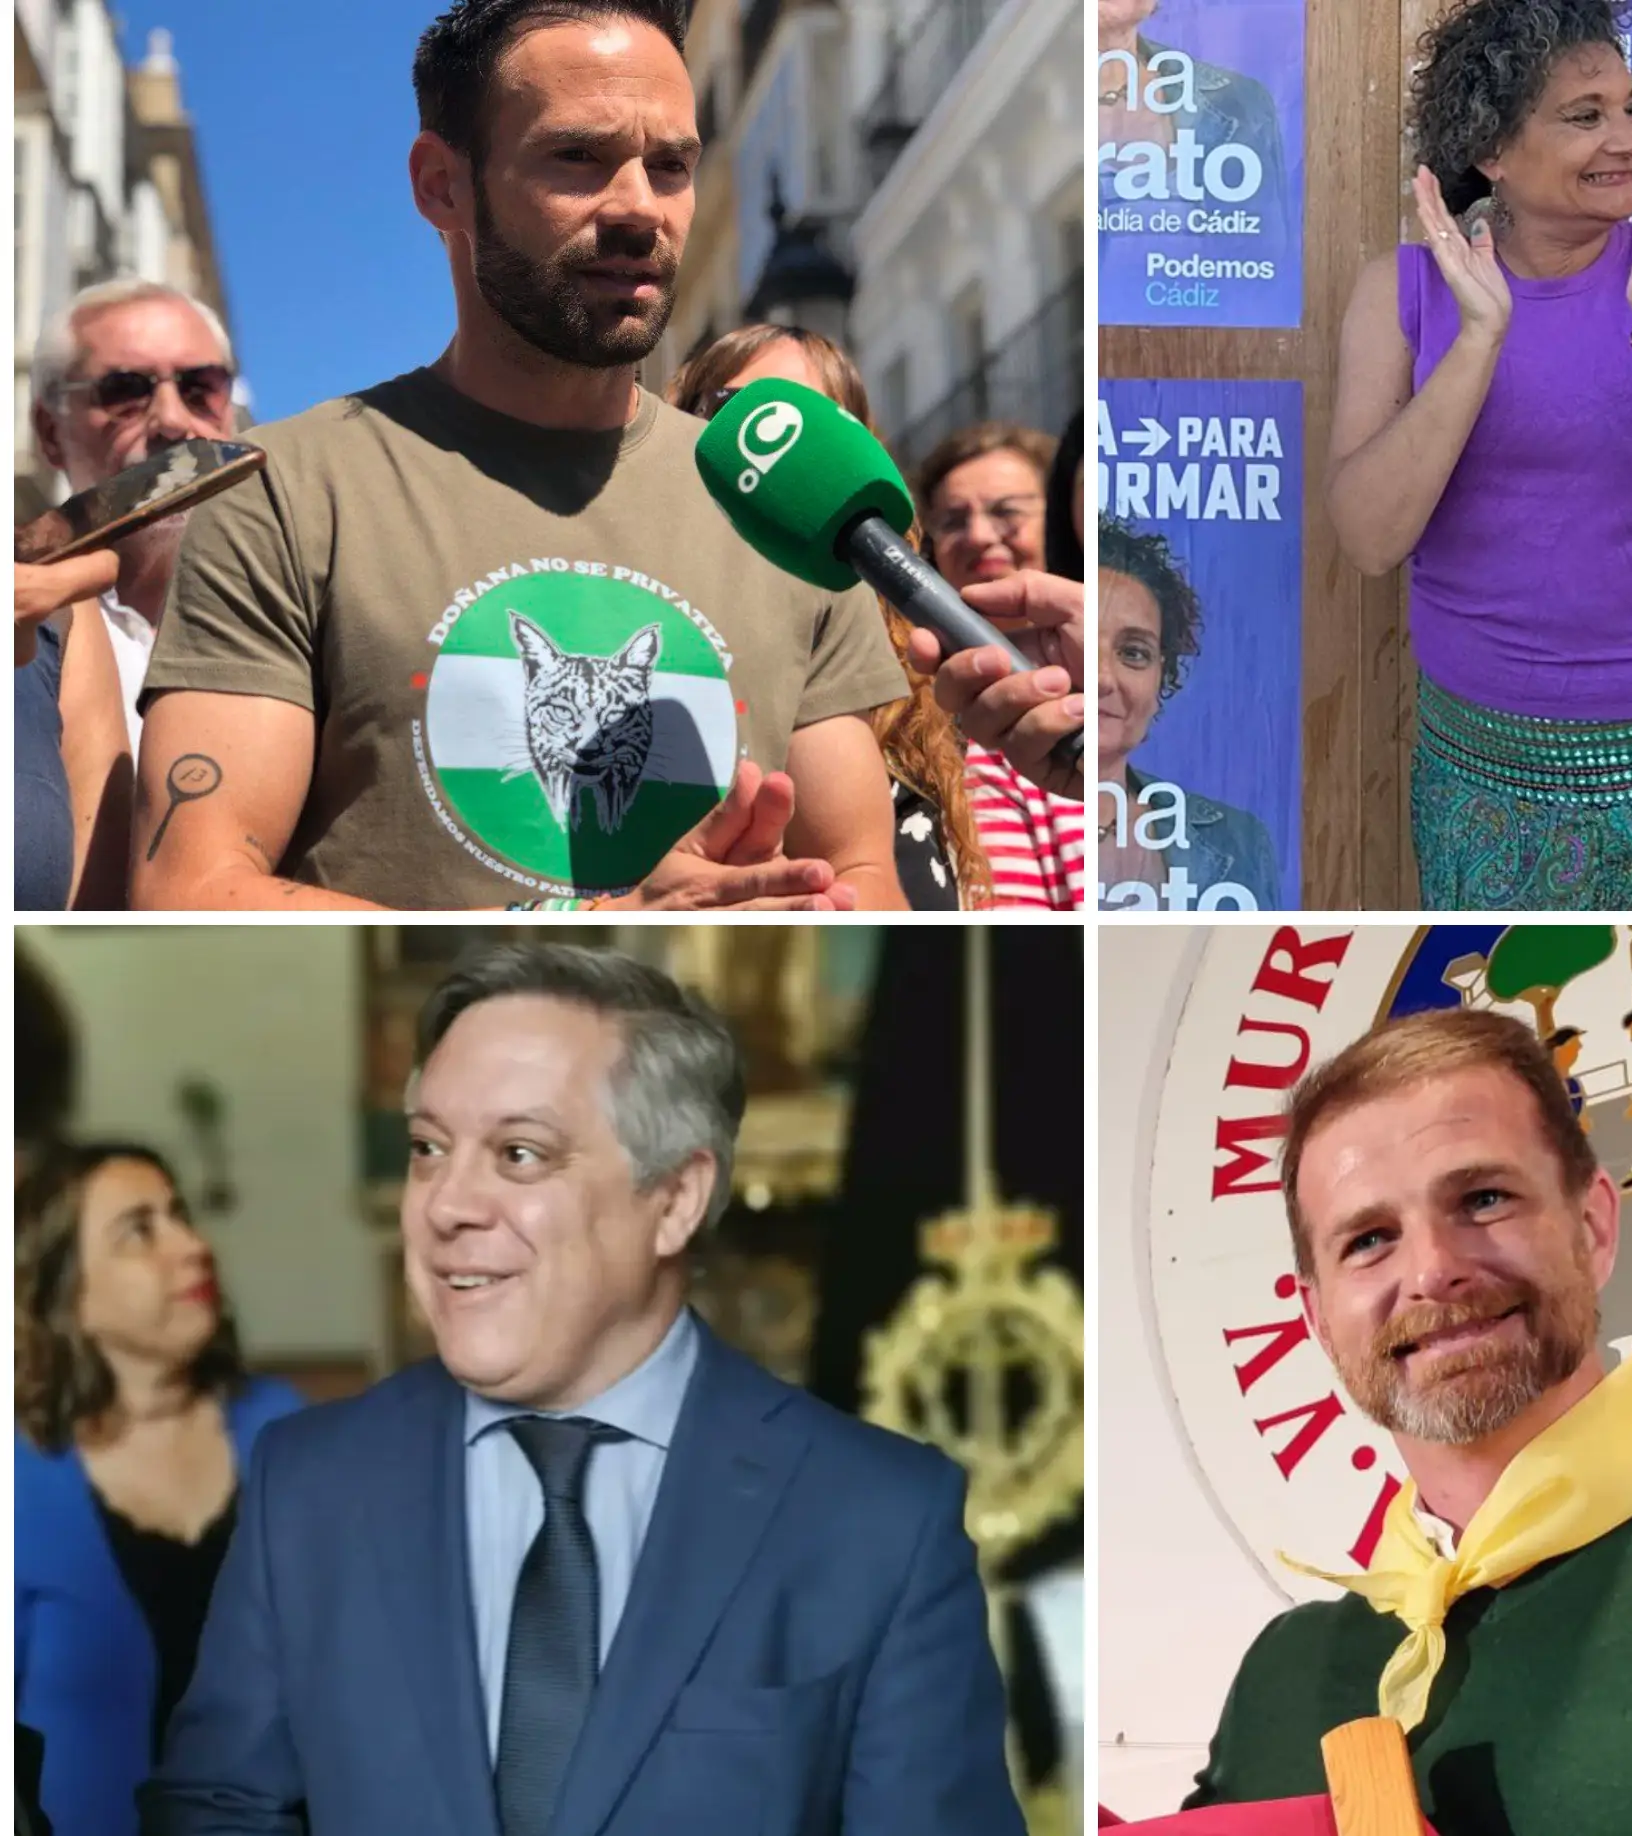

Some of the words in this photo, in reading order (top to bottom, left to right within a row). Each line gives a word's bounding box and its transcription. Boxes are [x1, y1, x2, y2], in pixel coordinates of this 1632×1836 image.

[1150, 209, 1182, 234] de
[1187, 208, 1261, 235] Cádiz
[1146, 252, 1276, 280] Podemos
[1145, 280, 1220, 308] Cádiz
[1178, 416, 1284, 458] PARA
[427, 562, 530, 646] DOÑANA
[530, 557, 570, 573] NO
[574, 560, 608, 577] SE
[612, 565, 733, 672] PRIVATIZA
[463, 838, 537, 888] NUESTRO
